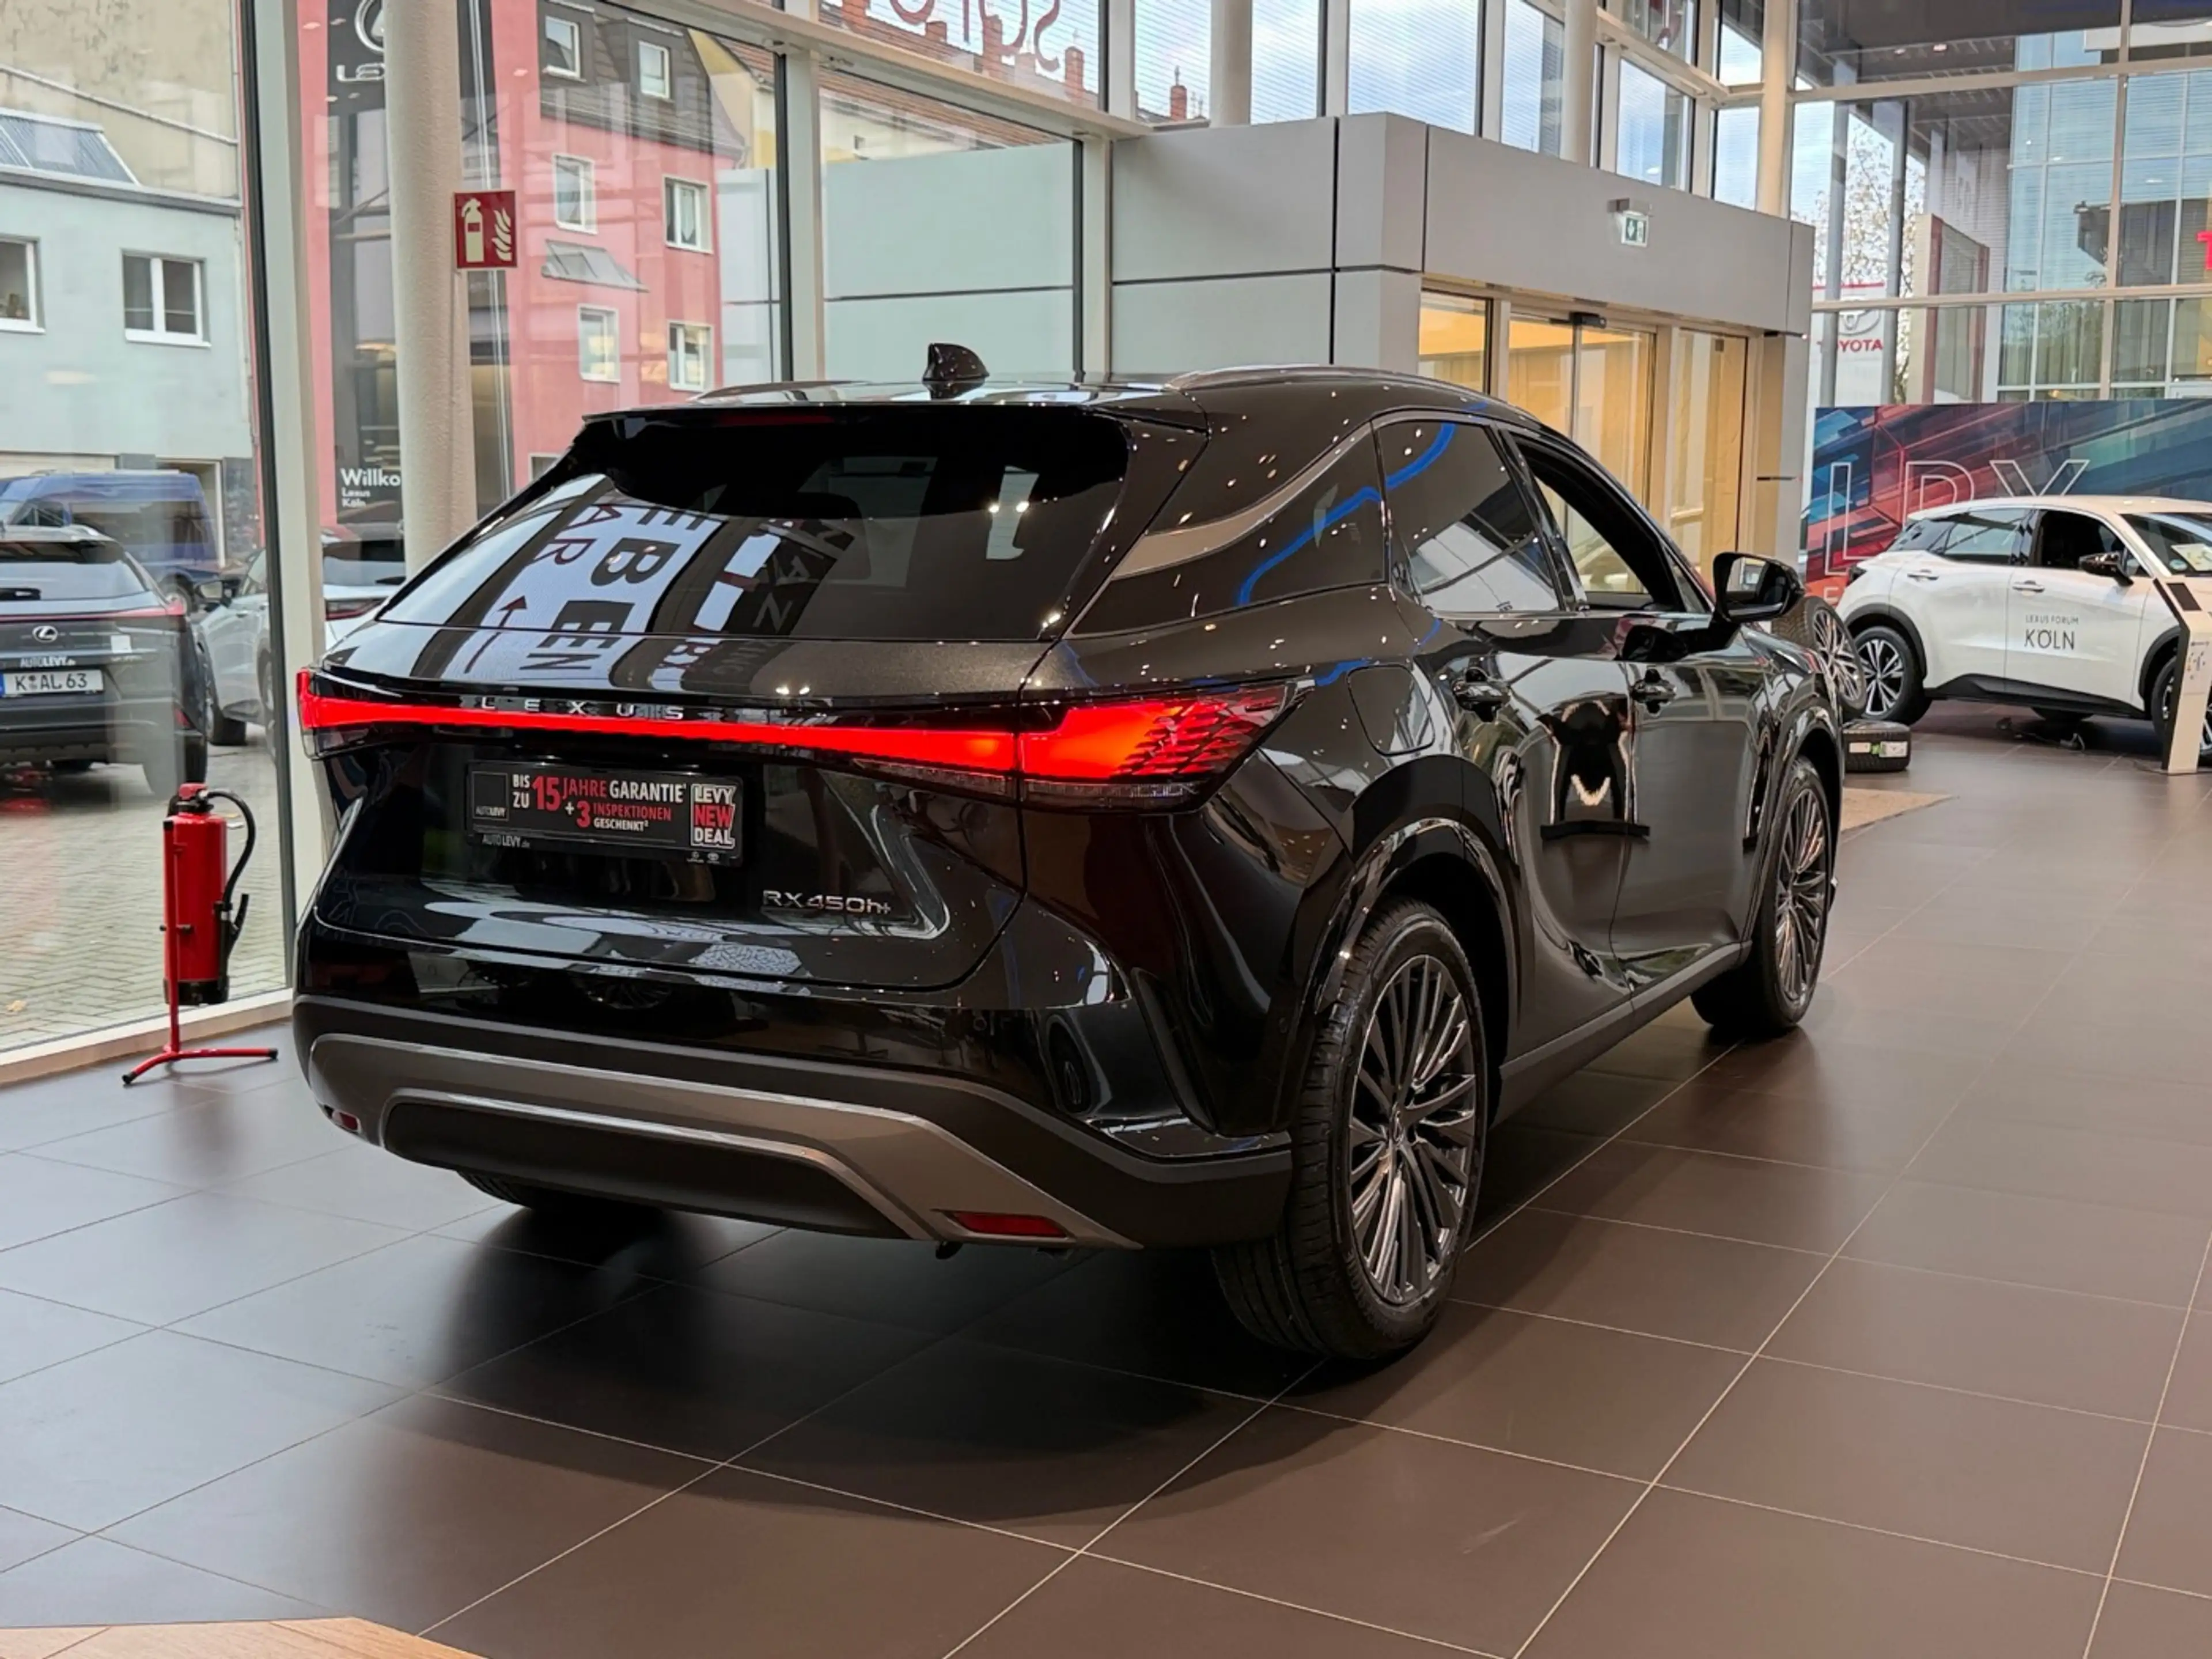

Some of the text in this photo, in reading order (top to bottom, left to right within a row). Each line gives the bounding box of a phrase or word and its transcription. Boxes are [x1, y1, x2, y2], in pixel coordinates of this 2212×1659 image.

[1817, 339, 1884, 353] YOTA
[66, 673, 88, 688] 63
[482, 696, 684, 719] LEXUS
[513, 774, 530, 788] BIS
[513, 791, 530, 809] ZU
[532, 776, 561, 811] 15
[563, 778, 607, 800] JAHRE
[694, 786, 733, 804] LEVY
[593, 802, 672, 821] INSPEKTIONEN
[694, 805, 732, 827] NEW
[694, 827, 733, 845] DEAL
